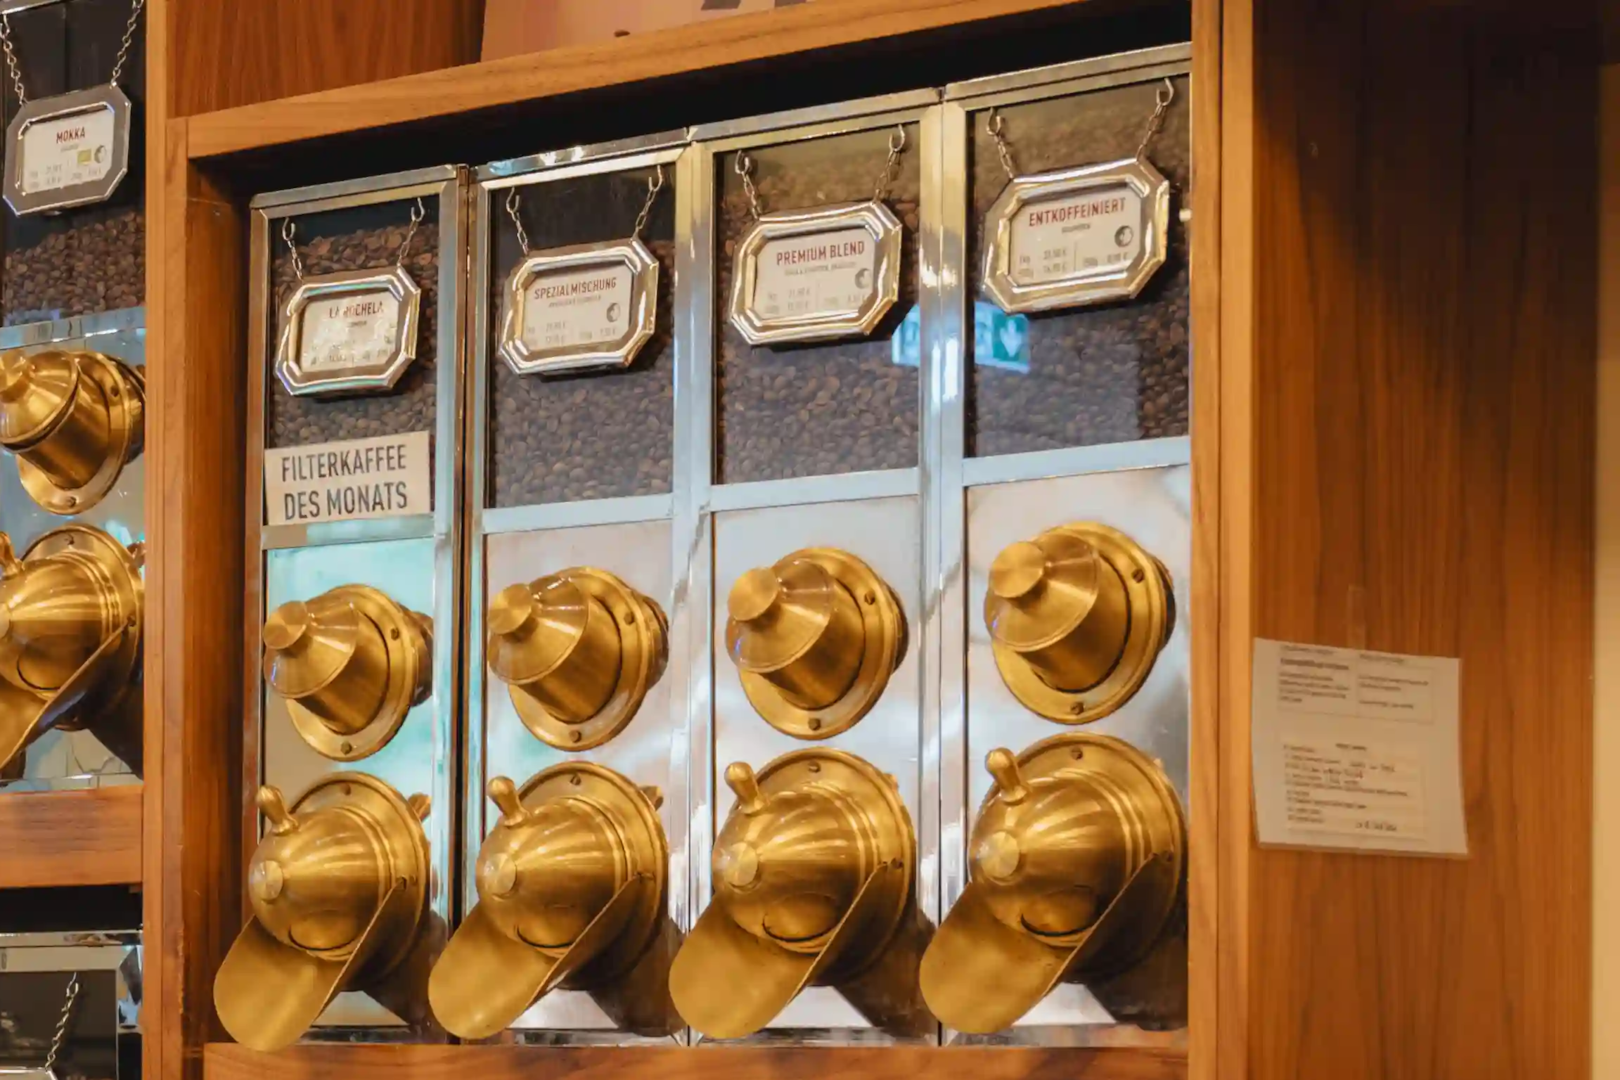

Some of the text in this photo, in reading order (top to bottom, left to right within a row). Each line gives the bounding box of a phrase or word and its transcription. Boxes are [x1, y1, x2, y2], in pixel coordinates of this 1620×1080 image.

[56, 125, 86, 144] MOKKA
[1029, 197, 1126, 227] ENTKOFFEINIERT
[776, 240, 865, 266] PREMIUM BLEND
[534, 277, 617, 300] SPEZIALMISCHUNG
[282, 444, 407, 482] FILTERKAFFEE
[284, 481, 408, 521] DES MONATS
